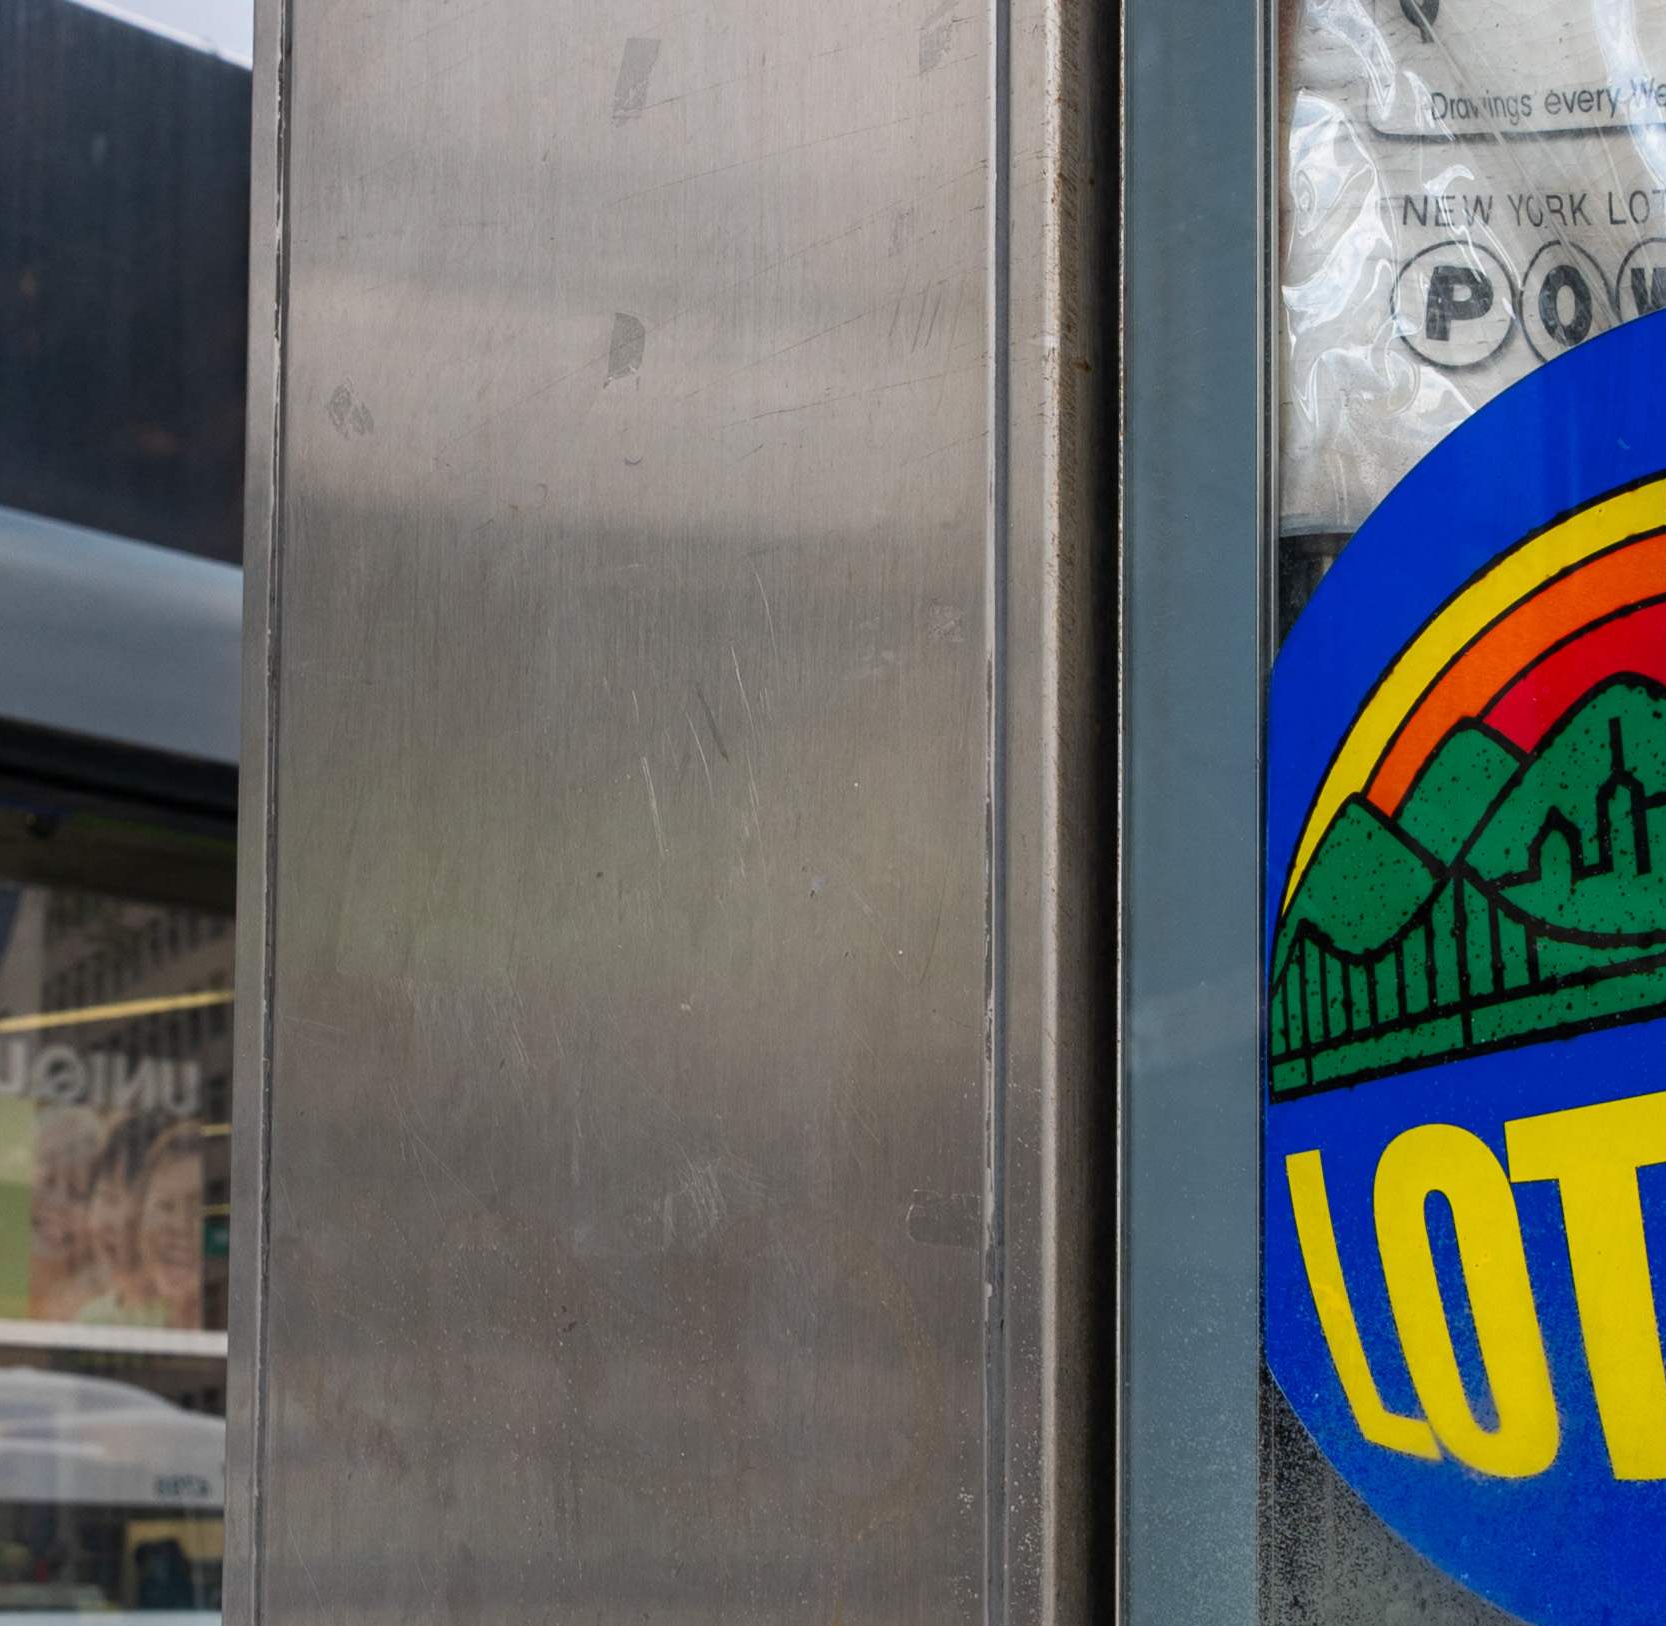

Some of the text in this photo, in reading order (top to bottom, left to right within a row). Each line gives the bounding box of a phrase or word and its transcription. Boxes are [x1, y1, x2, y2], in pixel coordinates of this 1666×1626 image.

[1431, 90, 1533, 126] Drawings
[1544, 87, 1621, 118] every
[1402, 193, 1493, 228] NEW
[1506, 191, 1589, 229] YORK
